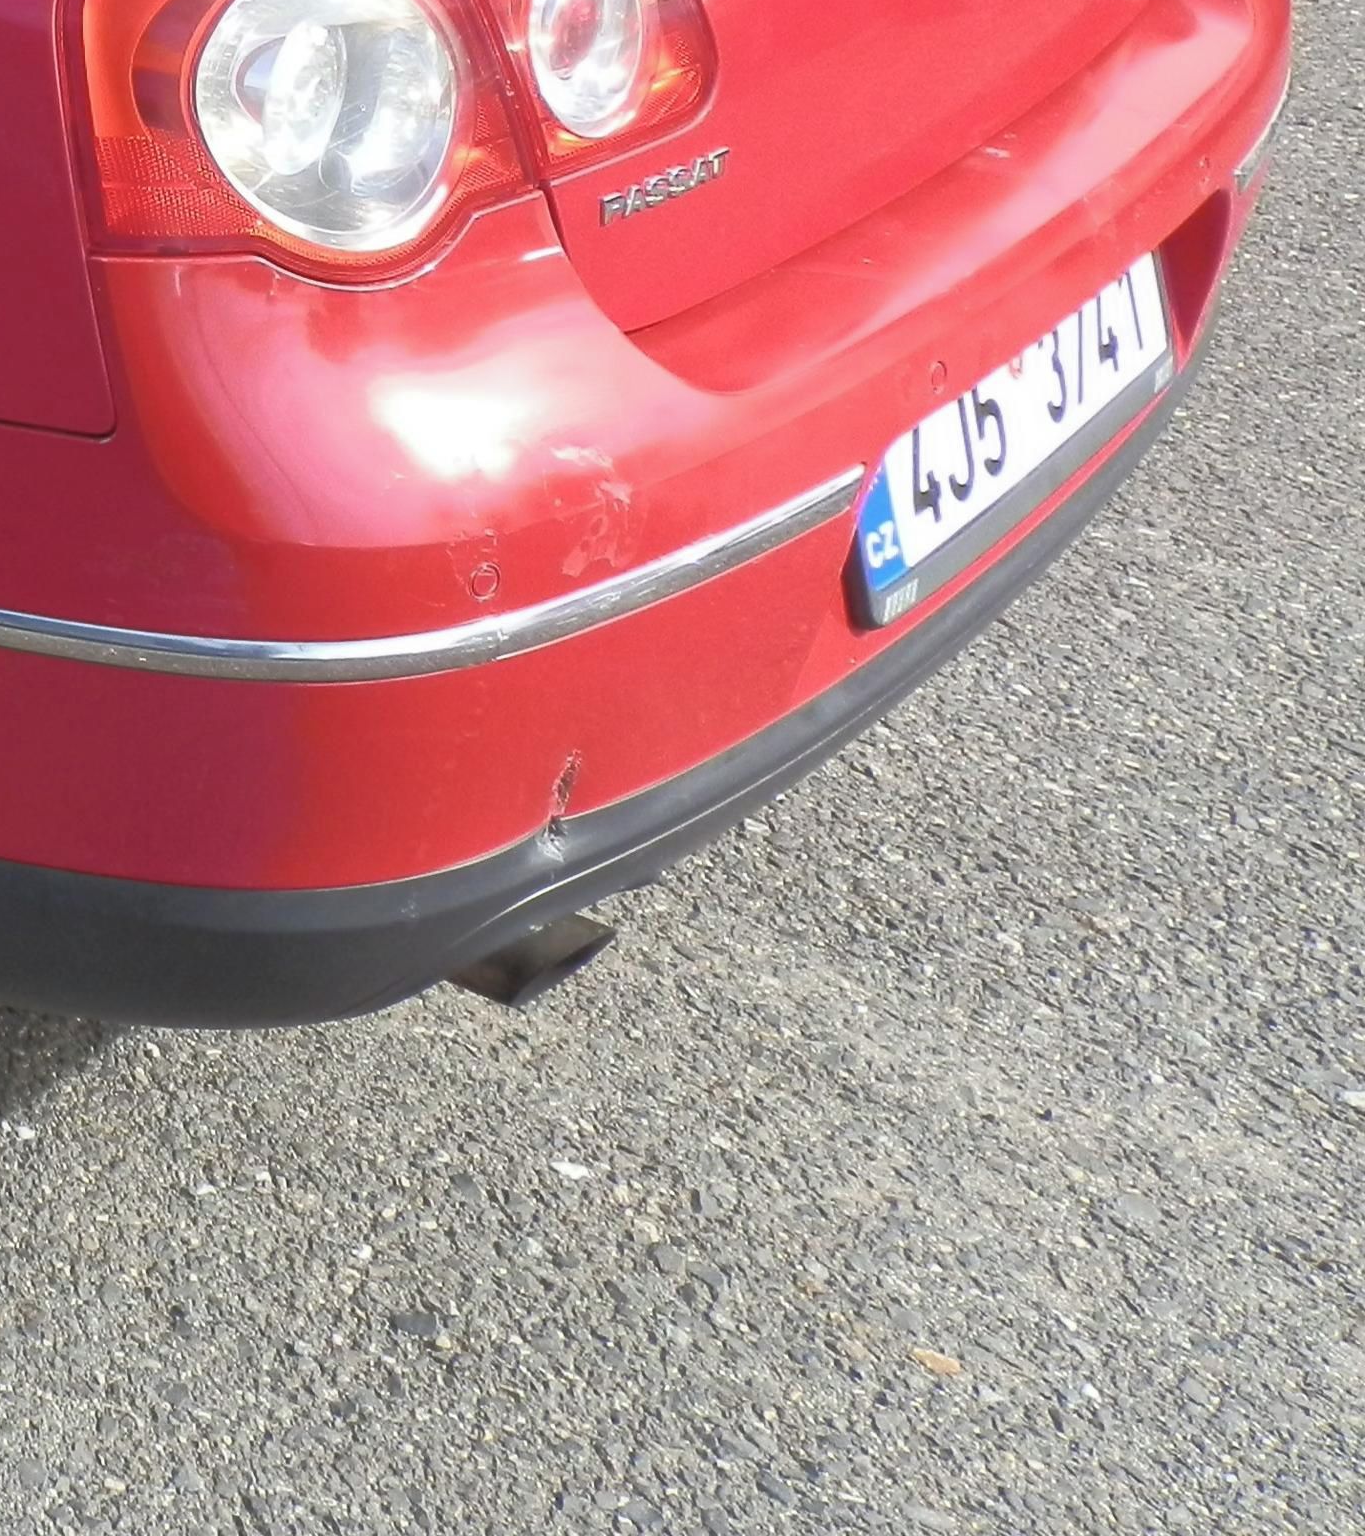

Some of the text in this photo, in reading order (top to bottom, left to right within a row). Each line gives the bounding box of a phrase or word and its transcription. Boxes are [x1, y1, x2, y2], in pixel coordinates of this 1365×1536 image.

[599, 147, 730, 227] PASSAT
[866, 520, 900, 569] CZ
[912, 386, 1007, 523] 4J5
